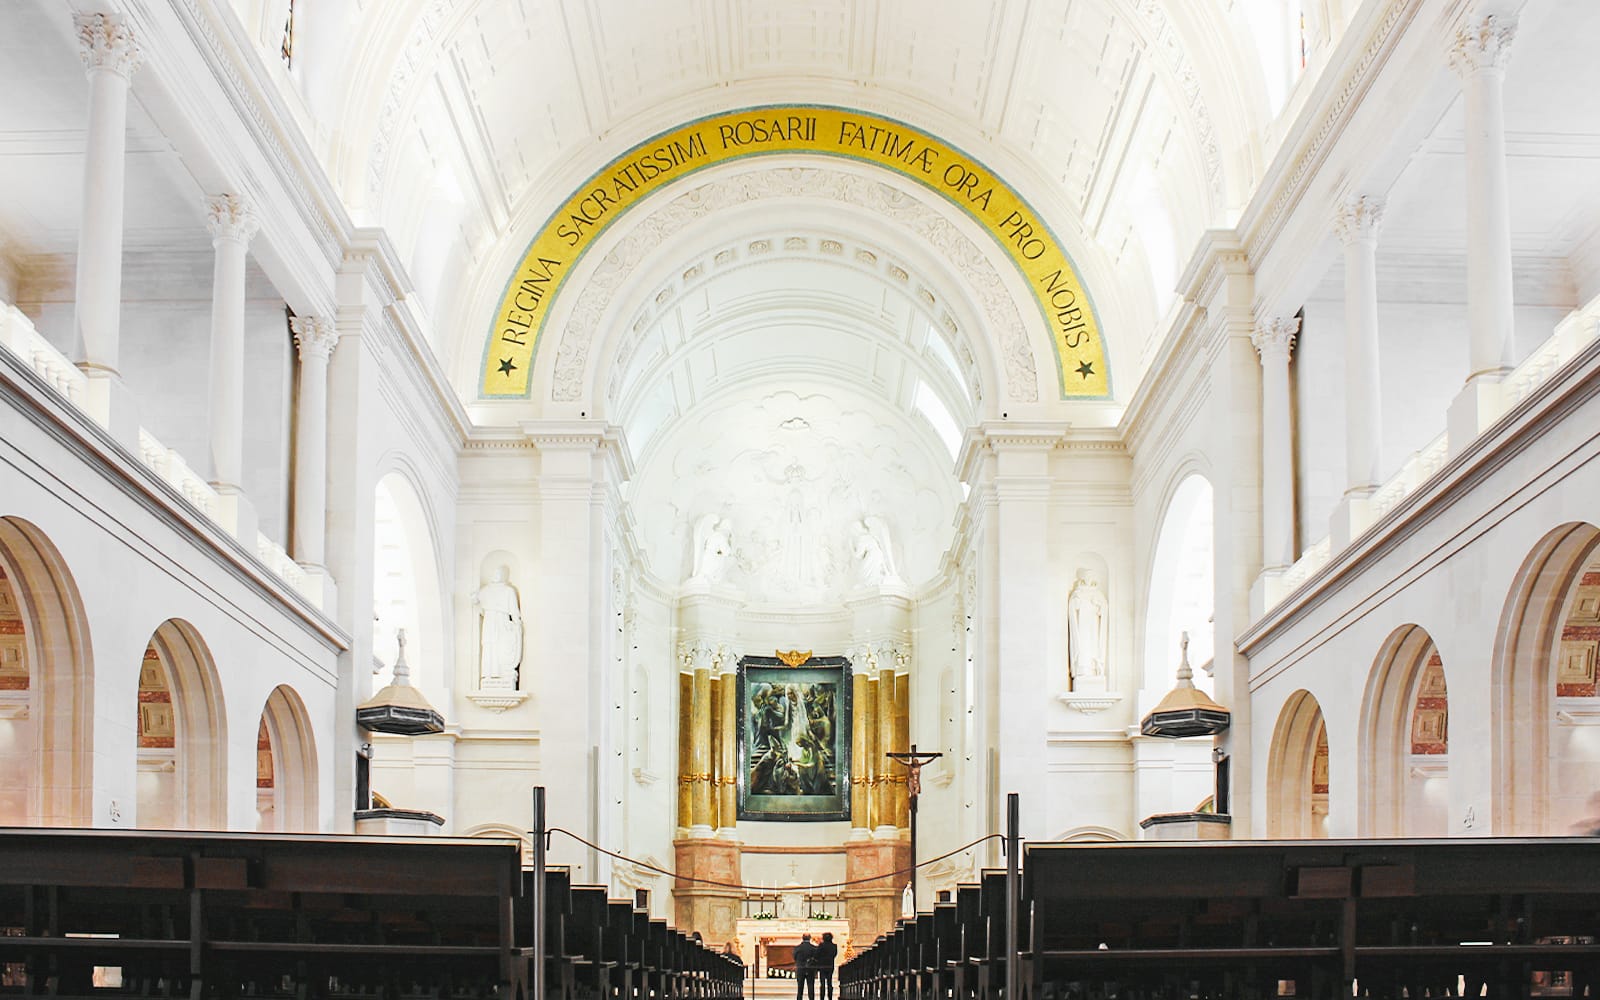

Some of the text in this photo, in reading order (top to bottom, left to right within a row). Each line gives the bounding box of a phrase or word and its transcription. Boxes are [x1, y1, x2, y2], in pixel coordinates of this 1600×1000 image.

[501, 116, 1090, 349] REGINA SACRATISSIMI ROSARII FATIMÆ ORA PRO NOBIS
